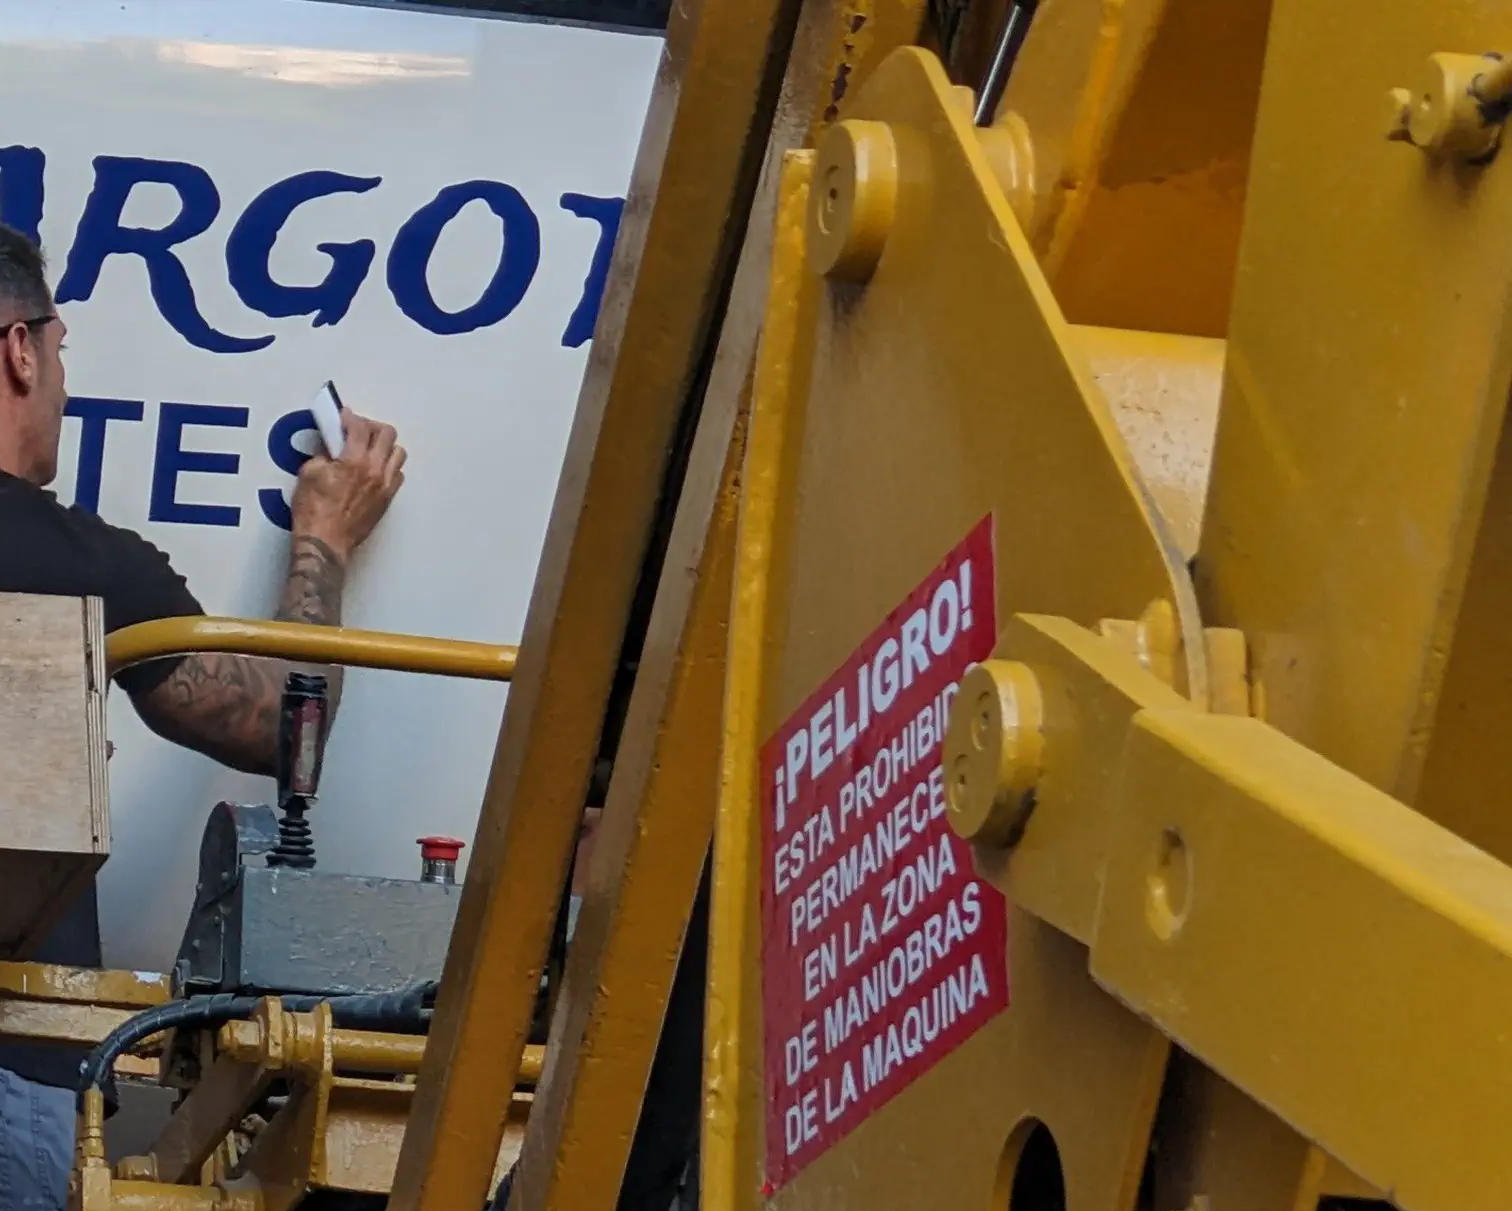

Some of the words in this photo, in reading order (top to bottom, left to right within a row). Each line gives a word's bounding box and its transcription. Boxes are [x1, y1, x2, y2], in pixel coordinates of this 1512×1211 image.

[775, 559, 973, 832] ¡PELIGRO!
[775, 805, 835, 896] ESTA
[839, 661, 978, 834] PROHIBI
[791, 764, 946, 947] PERMANECE
[804, 933, 837, 1002] EN
[843, 903, 878, 967] LA
[881, 832, 957, 936] ZONA
[784, 1019, 819, 1087] DE
[823, 881, 982, 1055] MANIOBRAS
[784, 1087, 819, 1156] DE
[823, 1060, 859, 1124] LA
[861, 953, 990, 1093] MAQUINA
